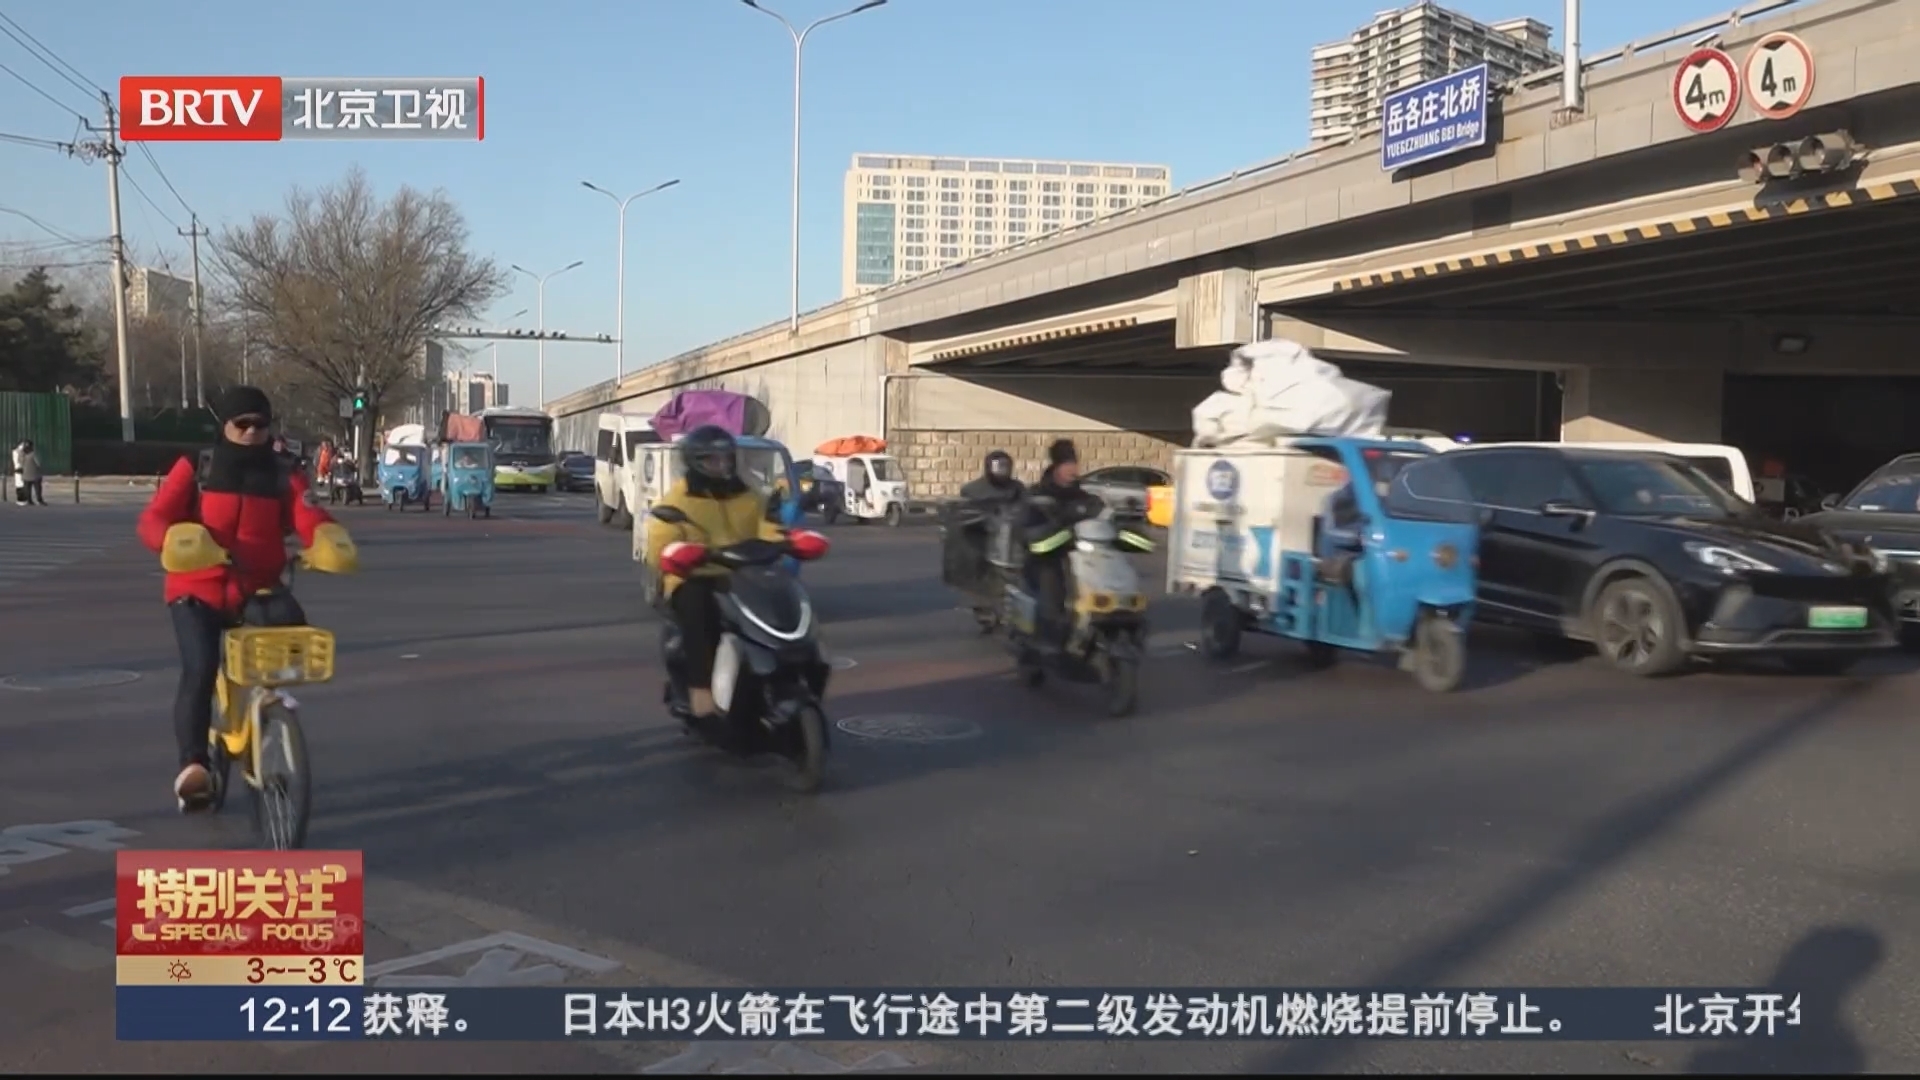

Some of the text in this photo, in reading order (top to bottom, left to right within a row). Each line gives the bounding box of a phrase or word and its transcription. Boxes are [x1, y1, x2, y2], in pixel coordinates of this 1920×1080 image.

[1387, 76, 1480, 137] 岳各庄北桥
[1386, 130, 1440, 158] YUEGEZHUANG
[1457, 120, 1480, 138] Bridge
